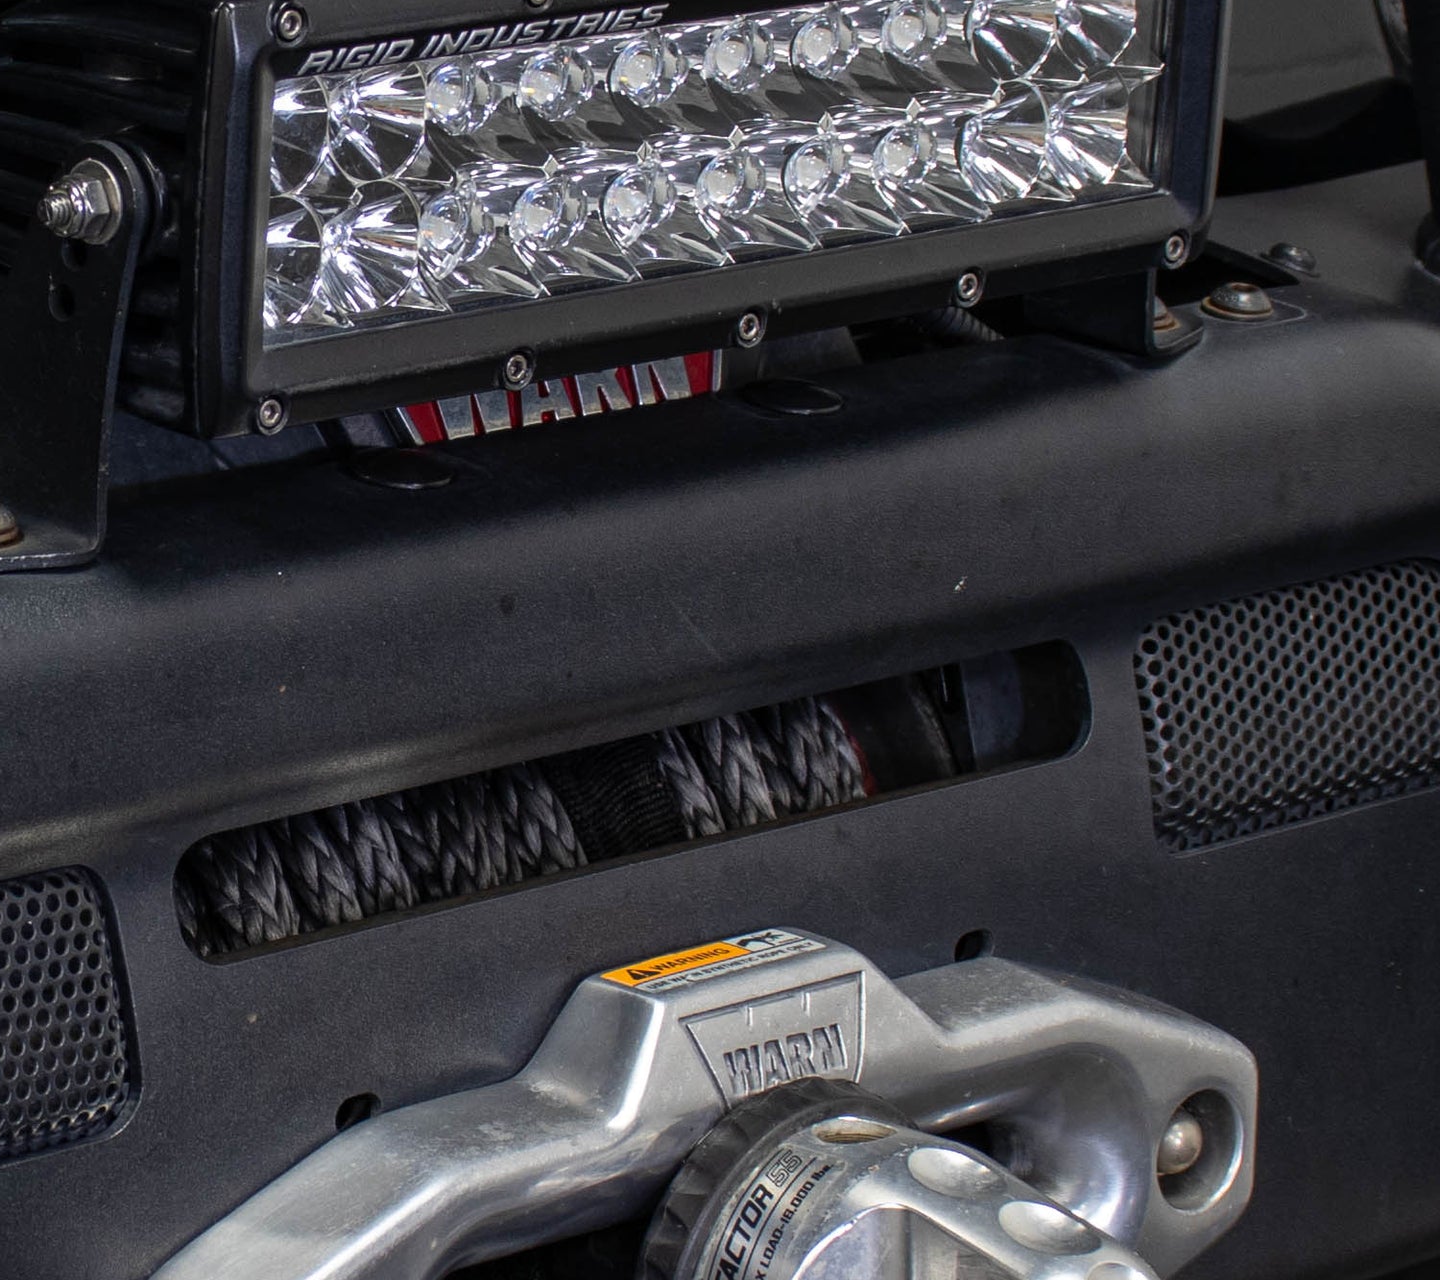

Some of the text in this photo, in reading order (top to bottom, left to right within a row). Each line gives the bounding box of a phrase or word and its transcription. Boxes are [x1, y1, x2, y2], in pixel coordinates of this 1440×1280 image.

[297, 3, 670, 75] RIGID INDUSTRIES
[646, 941, 814, 990] USE WAN SYNTHETIC ROPE ONLY
[651, 947, 731, 972] WARNING
[723, 1023, 848, 1097] WARN
[765, 1149, 803, 1188] 55
